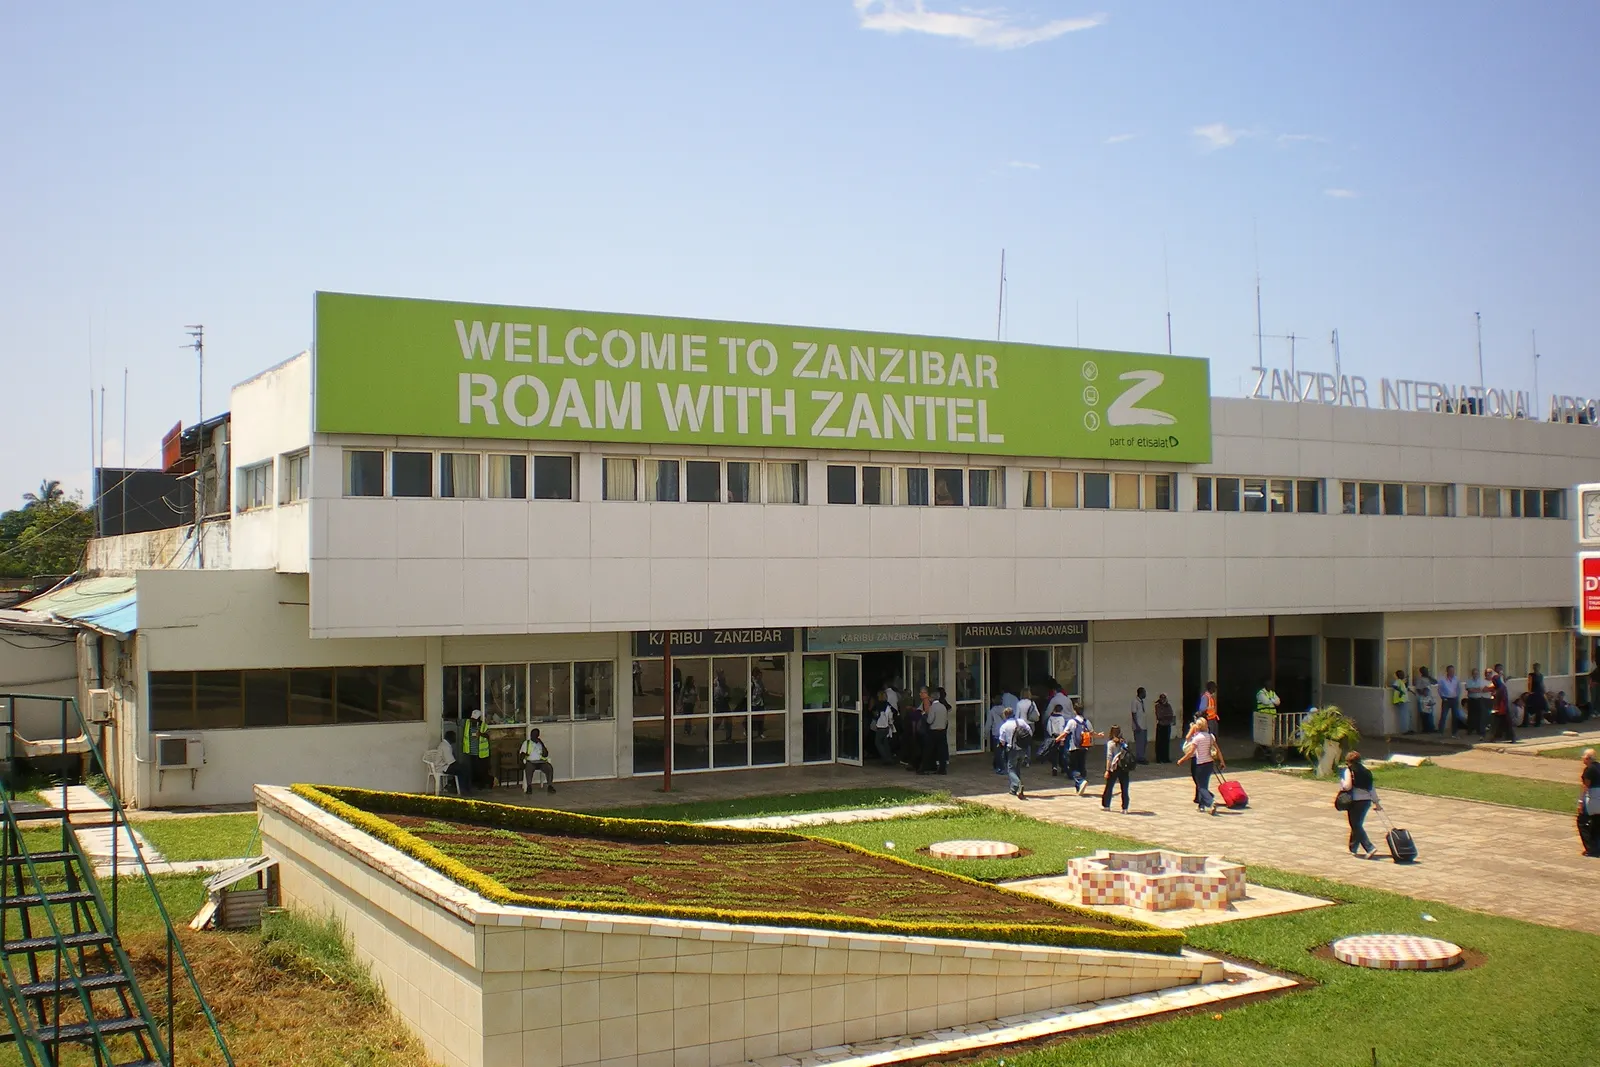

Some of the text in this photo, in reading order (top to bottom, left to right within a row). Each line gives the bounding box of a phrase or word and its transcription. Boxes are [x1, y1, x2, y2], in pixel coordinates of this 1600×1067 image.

[454, 319, 999, 389] WELCOME TO ZANZIBAR
[1251, 366, 1369, 407] ZANZIBAR
[1380, 377, 1539, 421] INTERNATIONAL
[458, 372, 1005, 444] ROAM WITH ZANTEL
[1109, 436, 1169, 448] part of etisalat
[714, 629, 782, 644] ZANZIBAR
[841, 632, 920, 642] KARIBU ZANZIBAR
[964, 626, 1013, 636] ARRIVALS
[1019, 624, 1084, 636] WANAOWASILI
